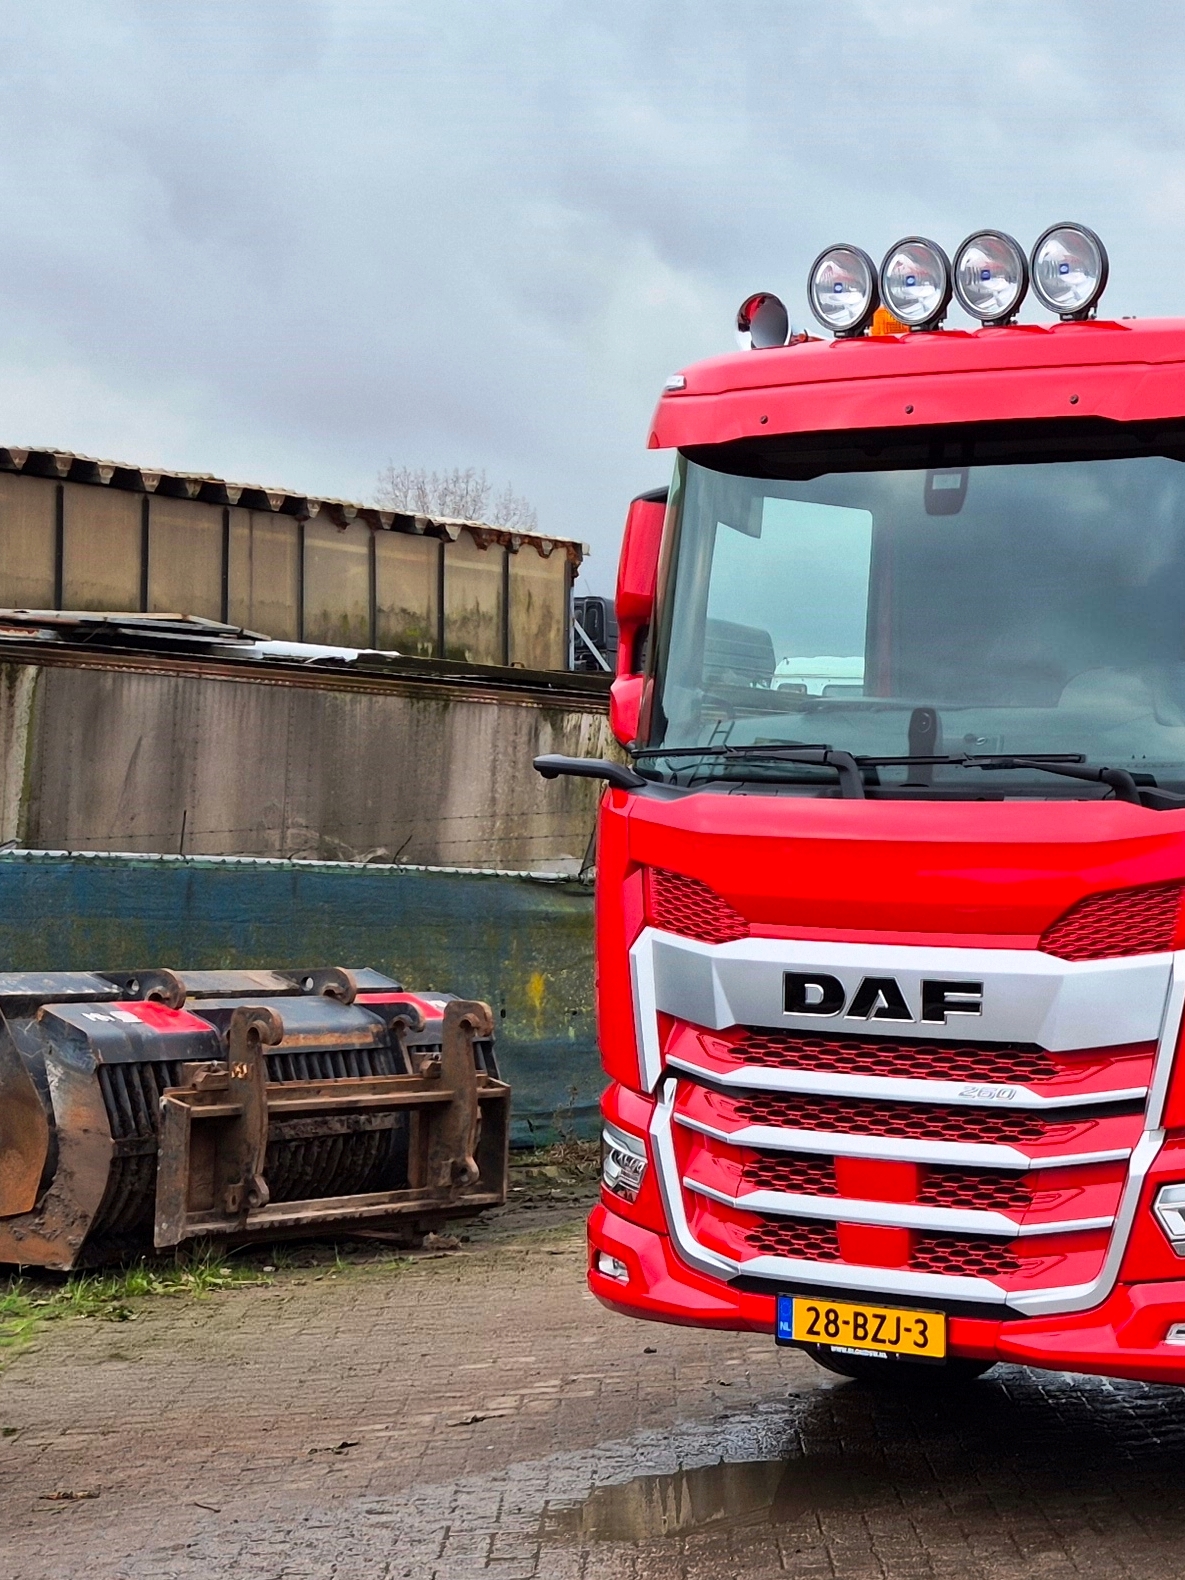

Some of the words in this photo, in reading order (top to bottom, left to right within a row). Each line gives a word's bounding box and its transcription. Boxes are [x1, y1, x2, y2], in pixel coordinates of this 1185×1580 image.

[782, 970, 984, 1025] DAF
[958, 1086, 1017, 1101] 260
[779, 1321, 792, 1332] NL
[805, 1306, 929, 1349] 28-BZJ-3
